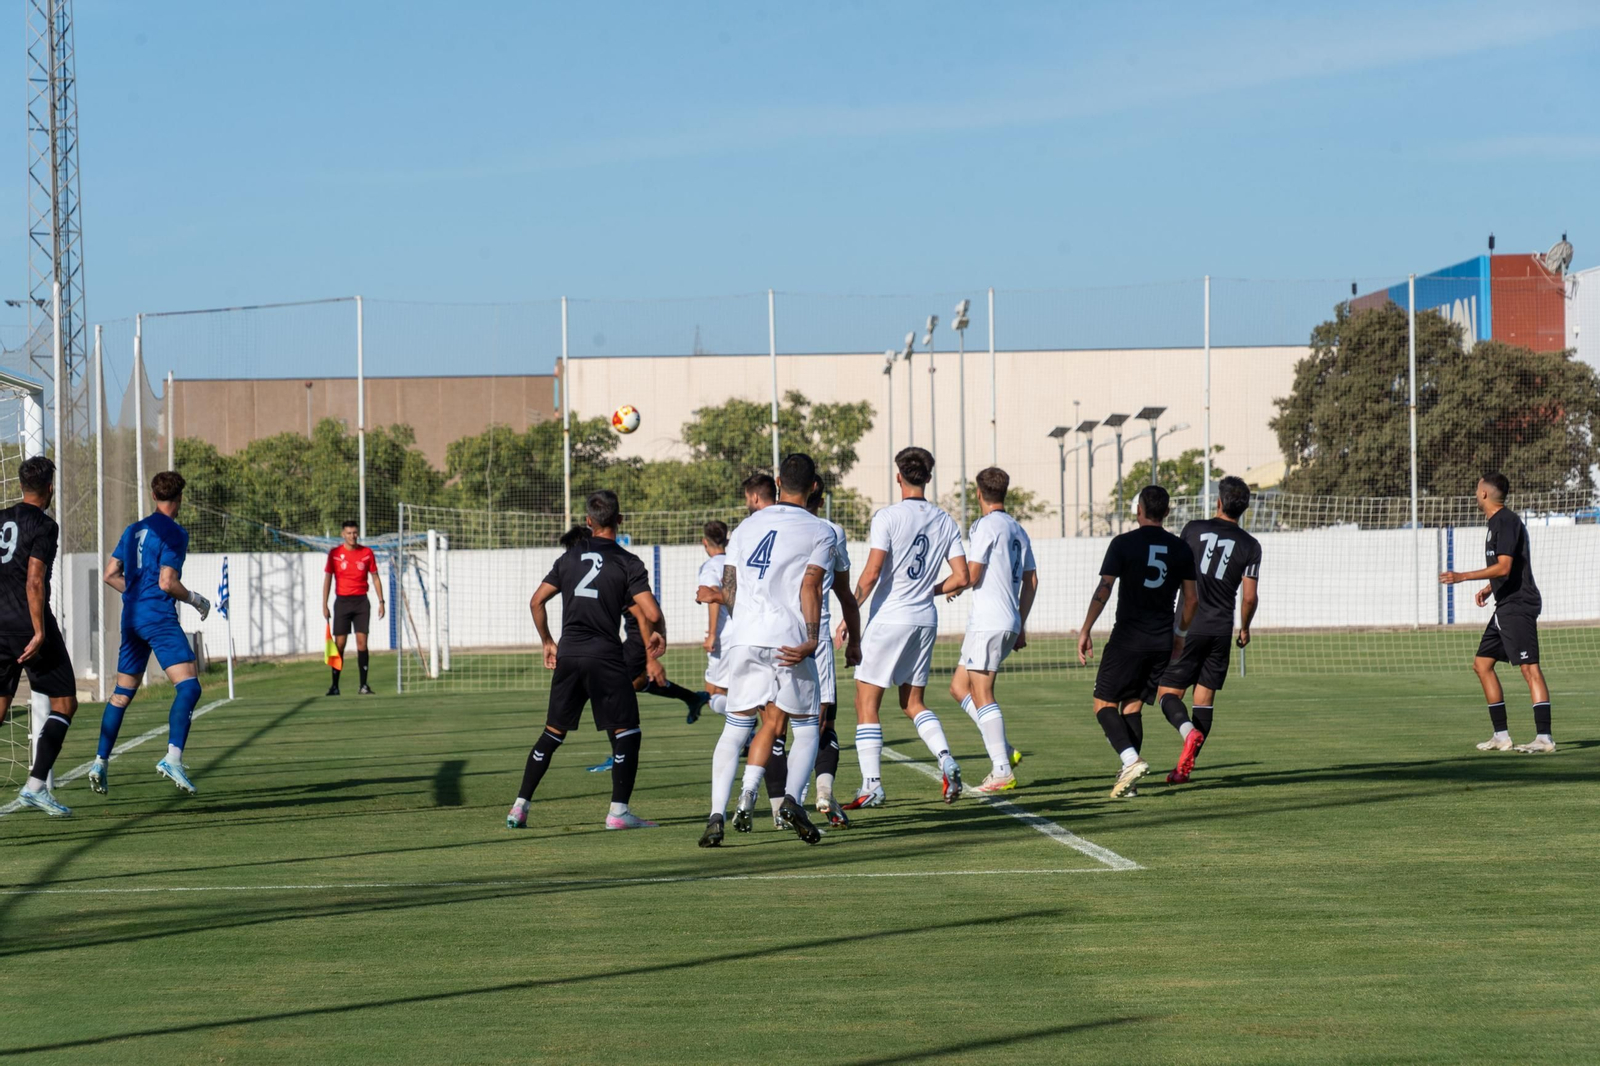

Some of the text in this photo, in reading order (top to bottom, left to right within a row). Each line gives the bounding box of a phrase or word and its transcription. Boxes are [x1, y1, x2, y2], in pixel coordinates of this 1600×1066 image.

[0, 521, 19, 564] 9
[135, 528, 149, 568] 1
[746, 530, 778, 579] 4
[907, 533, 930, 580] 3
[1011, 538, 1022, 584] 2
[1199, 532, 1236, 580] 11
[574, 551, 604, 599] 2
[1143, 545, 1169, 588] 5
